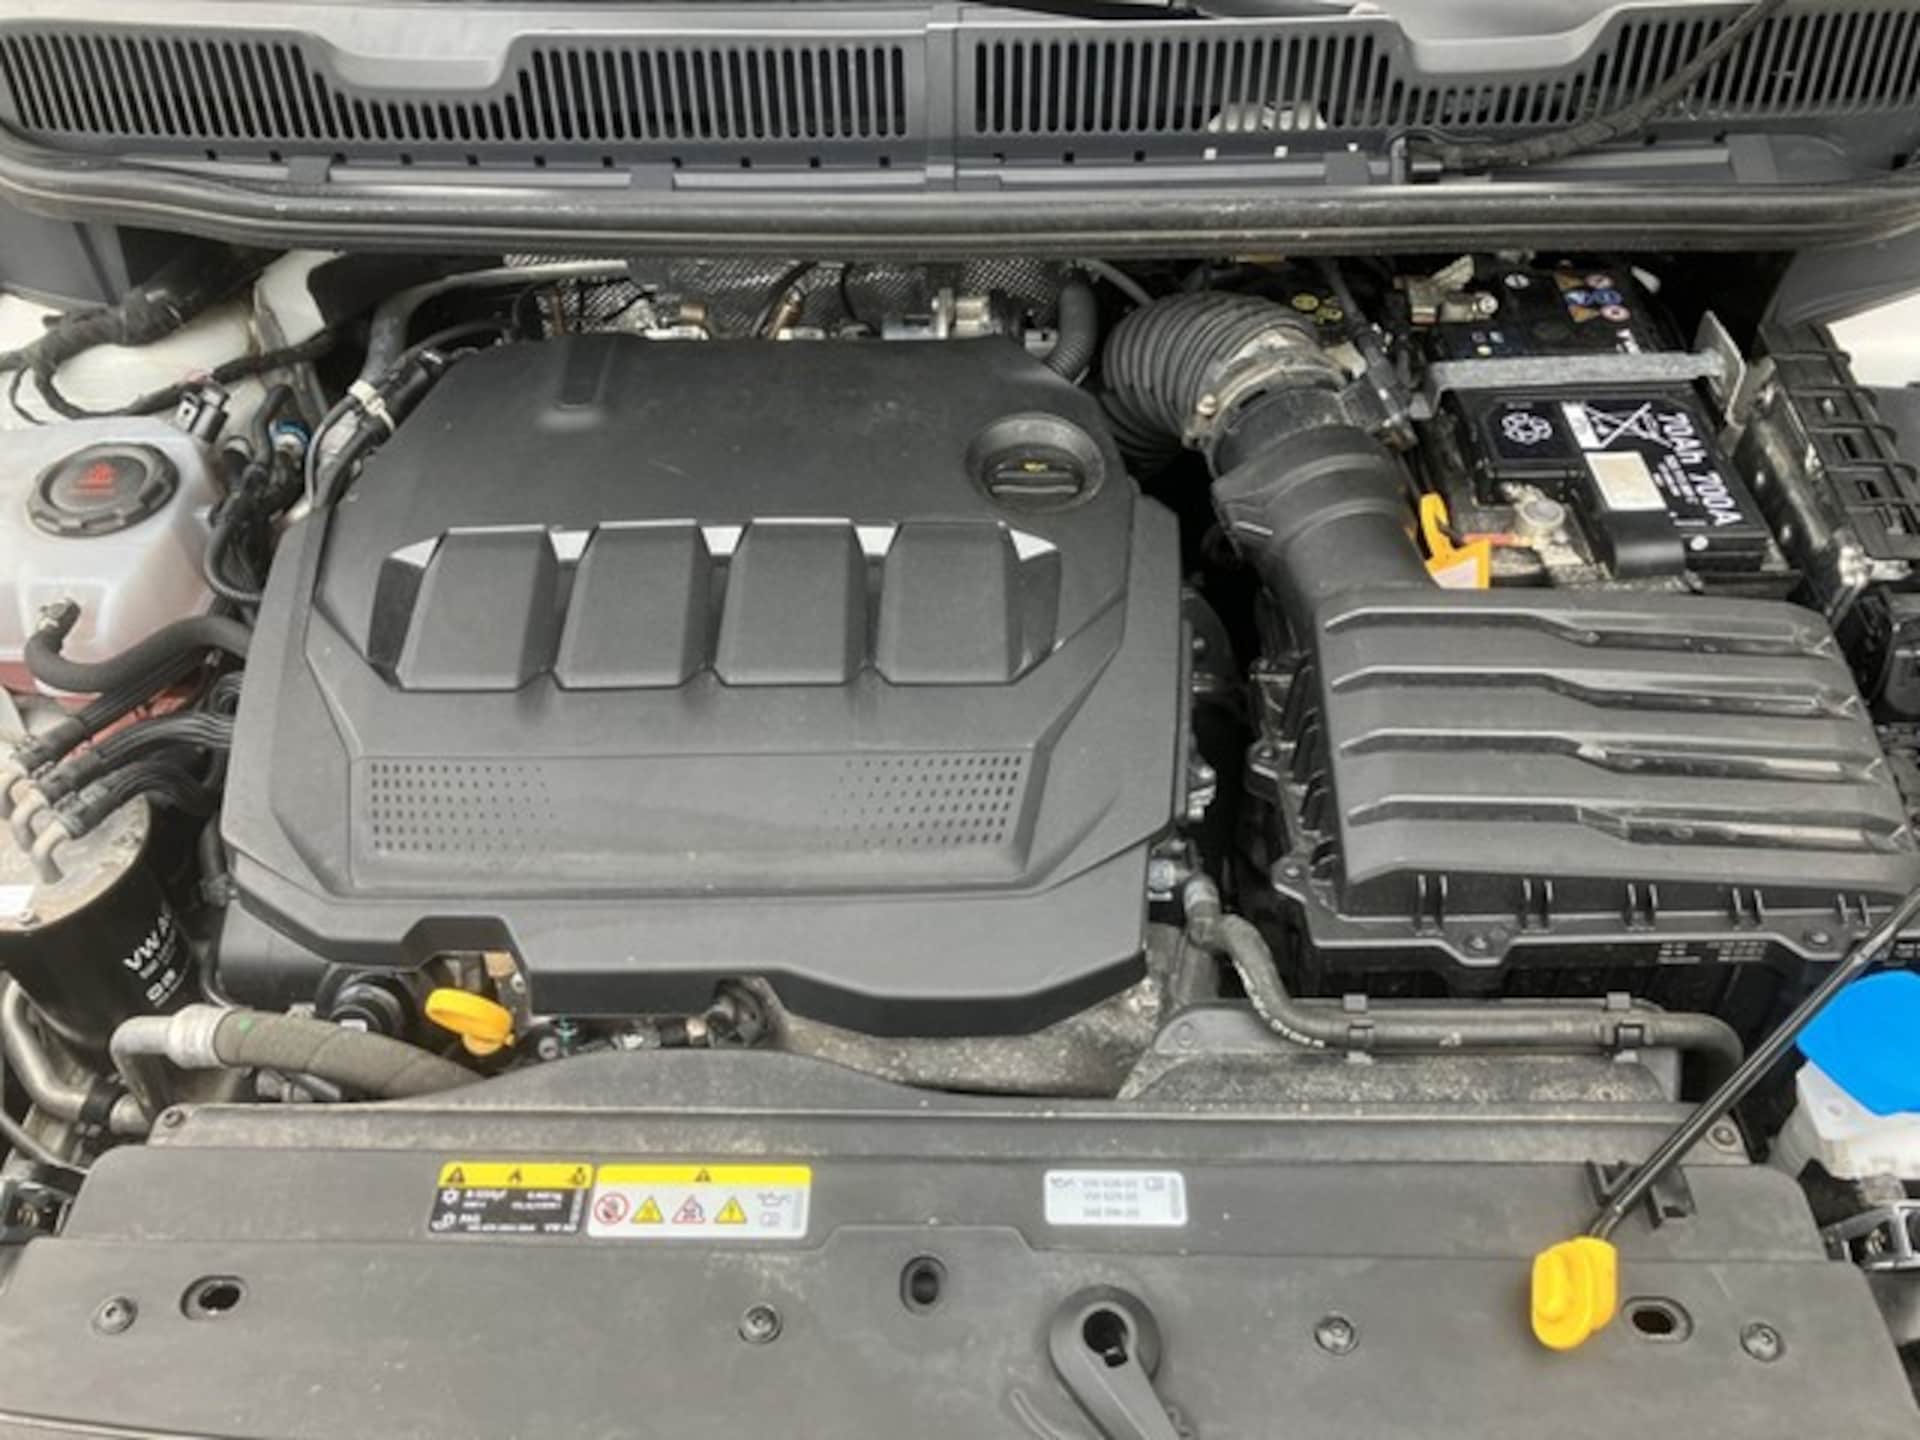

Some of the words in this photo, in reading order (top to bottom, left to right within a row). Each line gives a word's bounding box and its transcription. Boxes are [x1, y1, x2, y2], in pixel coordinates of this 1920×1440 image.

[1657, 412, 1707, 464] 70Ah
[1688, 471, 1743, 527] 700A
[122, 930, 160, 970] VW
